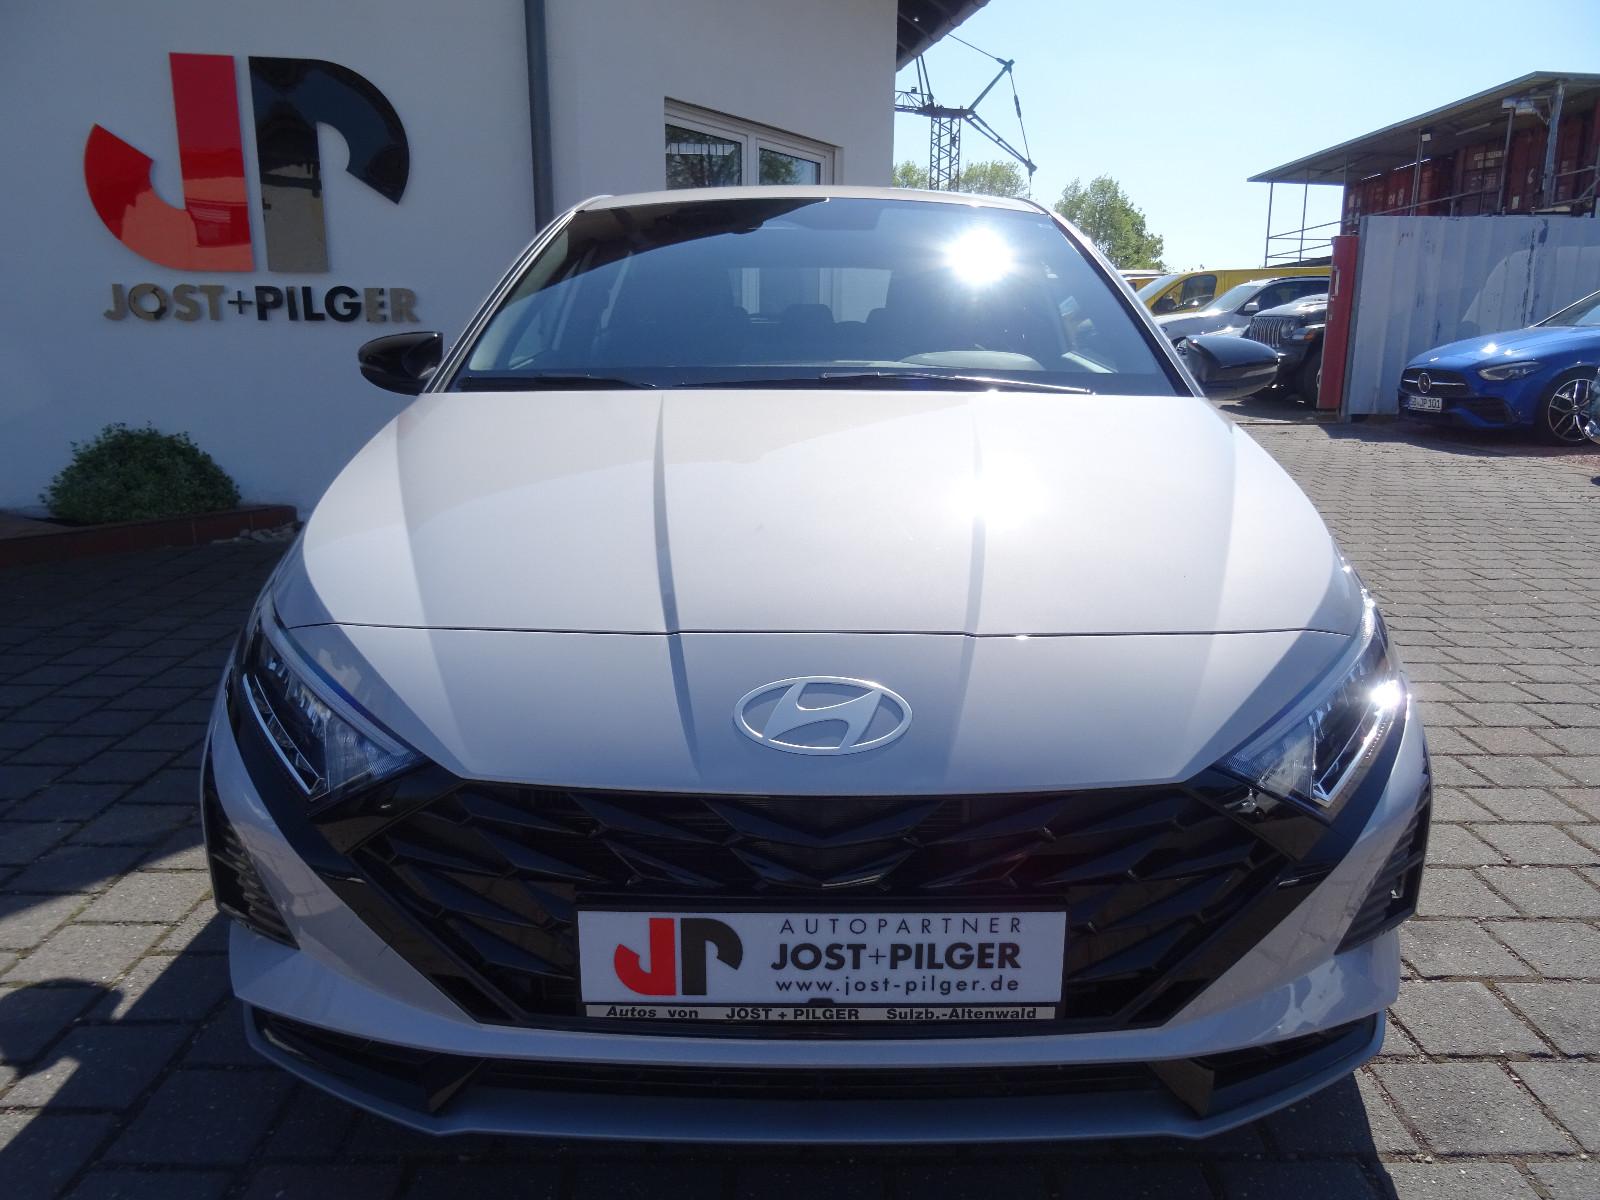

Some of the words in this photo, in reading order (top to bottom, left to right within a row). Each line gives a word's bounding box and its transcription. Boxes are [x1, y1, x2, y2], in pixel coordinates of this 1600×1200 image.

[103, 283, 422, 324] JOST+PILGER
[779, 917, 1022, 935] AUTOPARTNER
[771, 942, 1022, 971] JOST+PILGER
[776, 974, 1020, 995] www.jost-pilger.de
[605, 1005, 657, 1019] Autos
[667, 1009, 700, 1019] von
[725, 1007, 774, 1020] JOST
[793, 1007, 861, 1020] PILGER
[886, 1007, 1037, 1020] Sulzb.-Altenwald
